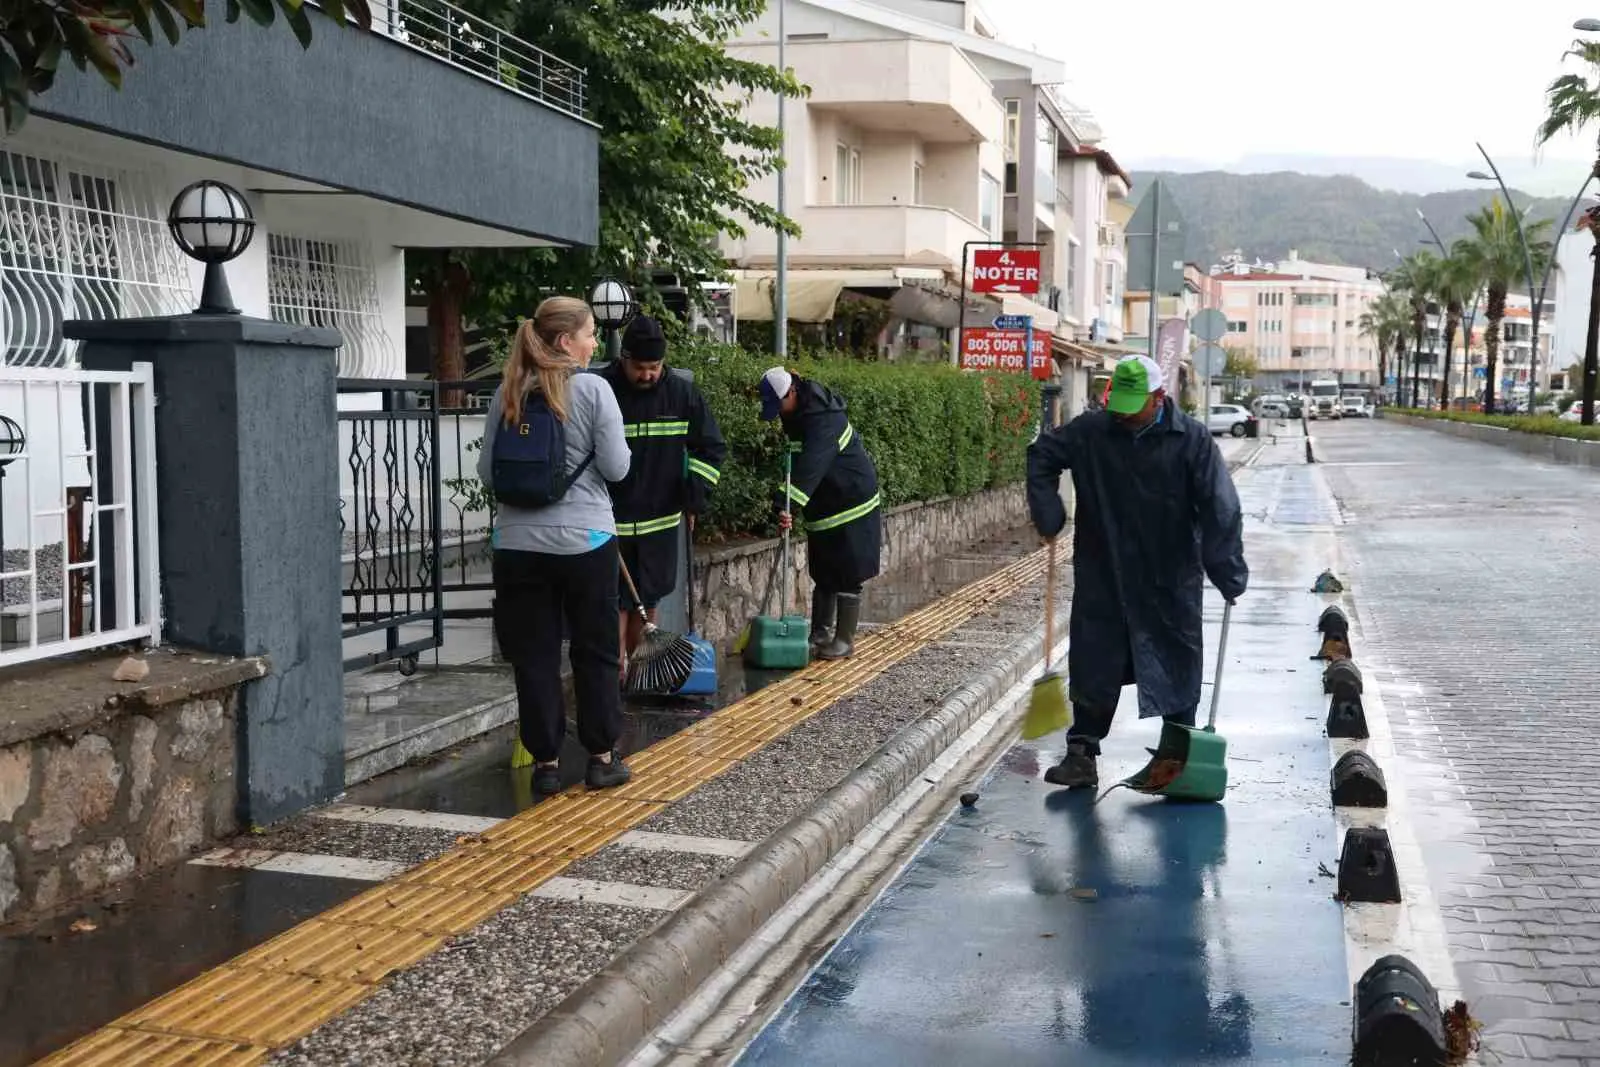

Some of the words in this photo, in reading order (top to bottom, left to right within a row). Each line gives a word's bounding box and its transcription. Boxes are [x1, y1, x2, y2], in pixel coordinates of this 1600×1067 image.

[999, 252, 1015, 265] 4.
[974, 267, 1038, 280] NOTER
[968, 338, 991, 353] BOŞ
[993, 339, 1018, 352] ODA
[964, 353, 997, 367] ROOM
[1000, 354, 1024, 368] FOR
